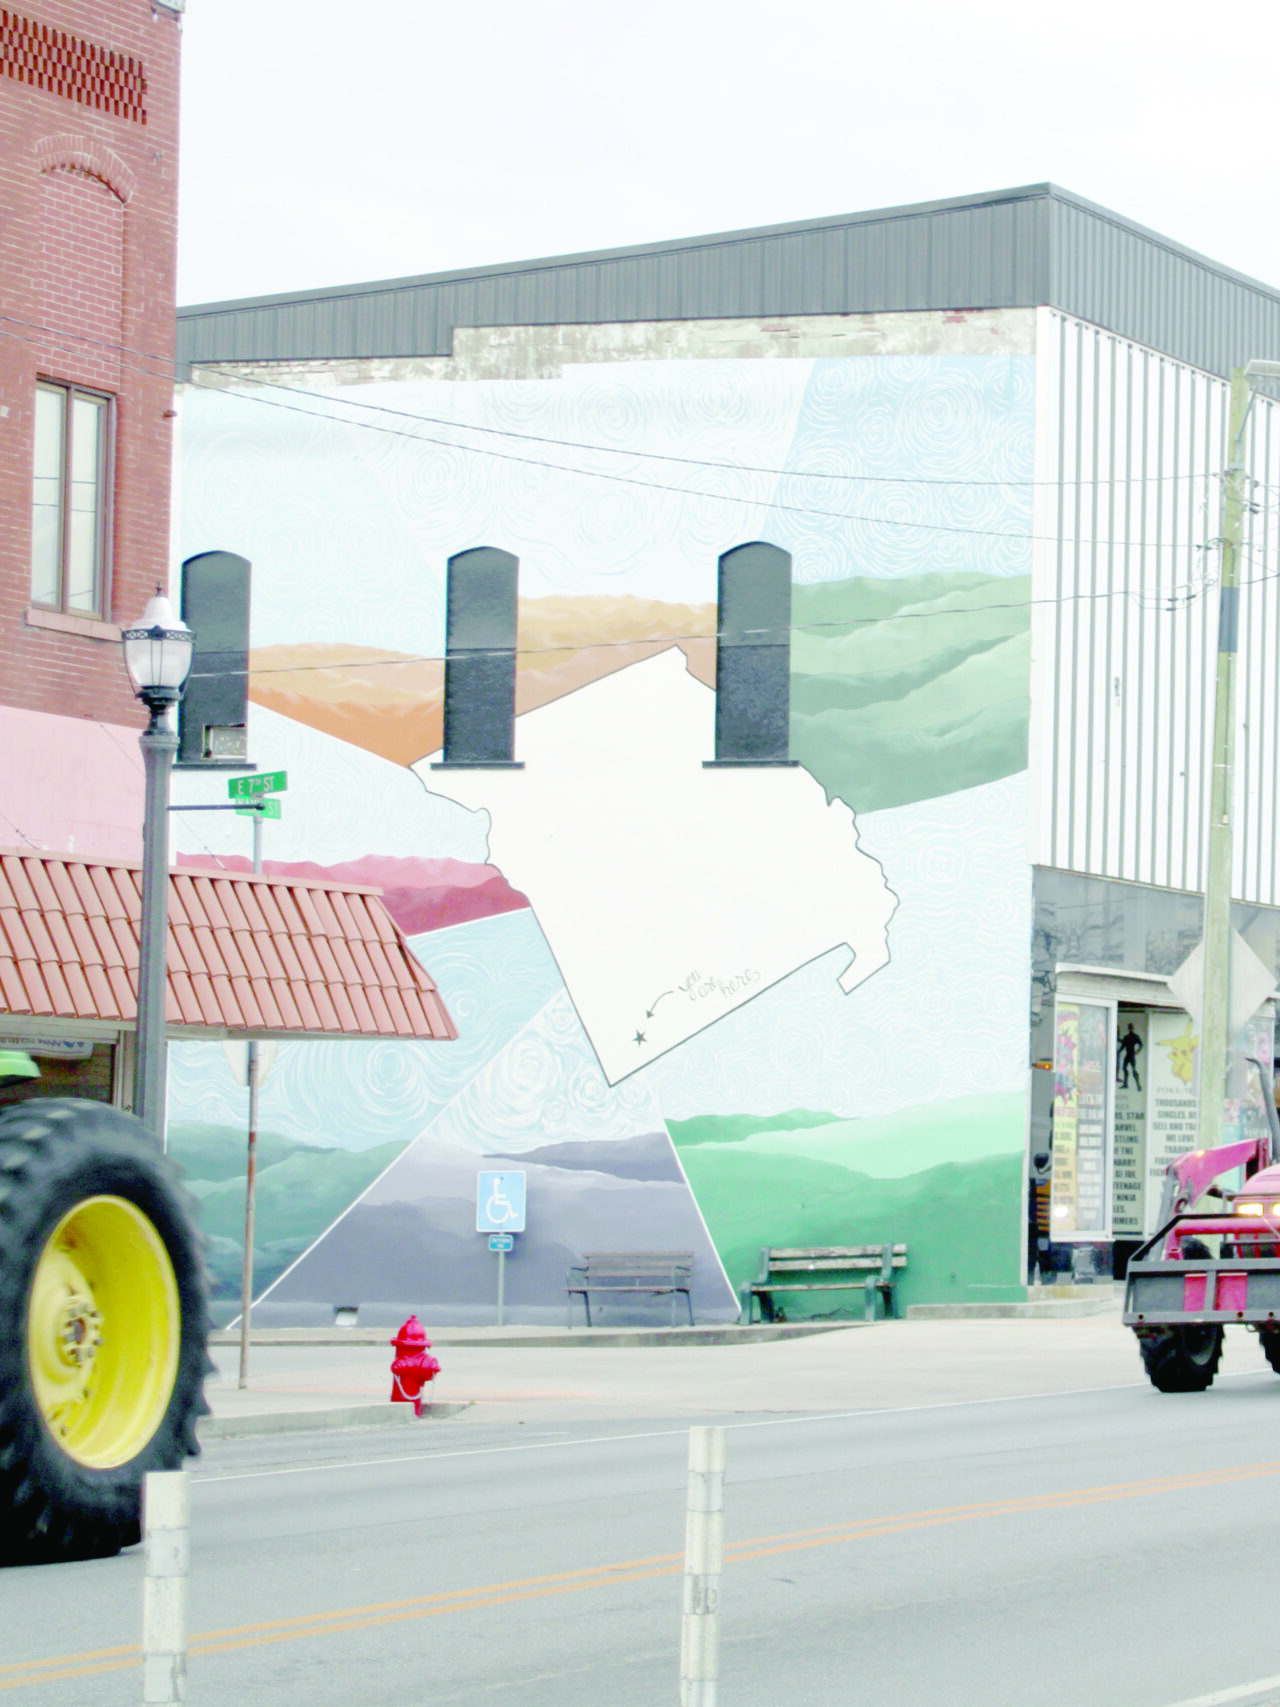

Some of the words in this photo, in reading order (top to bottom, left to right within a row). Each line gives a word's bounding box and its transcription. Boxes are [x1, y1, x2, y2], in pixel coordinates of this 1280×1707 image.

[237, 780, 245, 795] E
[263, 776, 275, 792] ST
[698, 976, 719, 999] are
[718, 968, 761, 999] here
[1169, 1121, 1183, 1130] AND
[1178, 1134, 1195, 1142] LOVE
